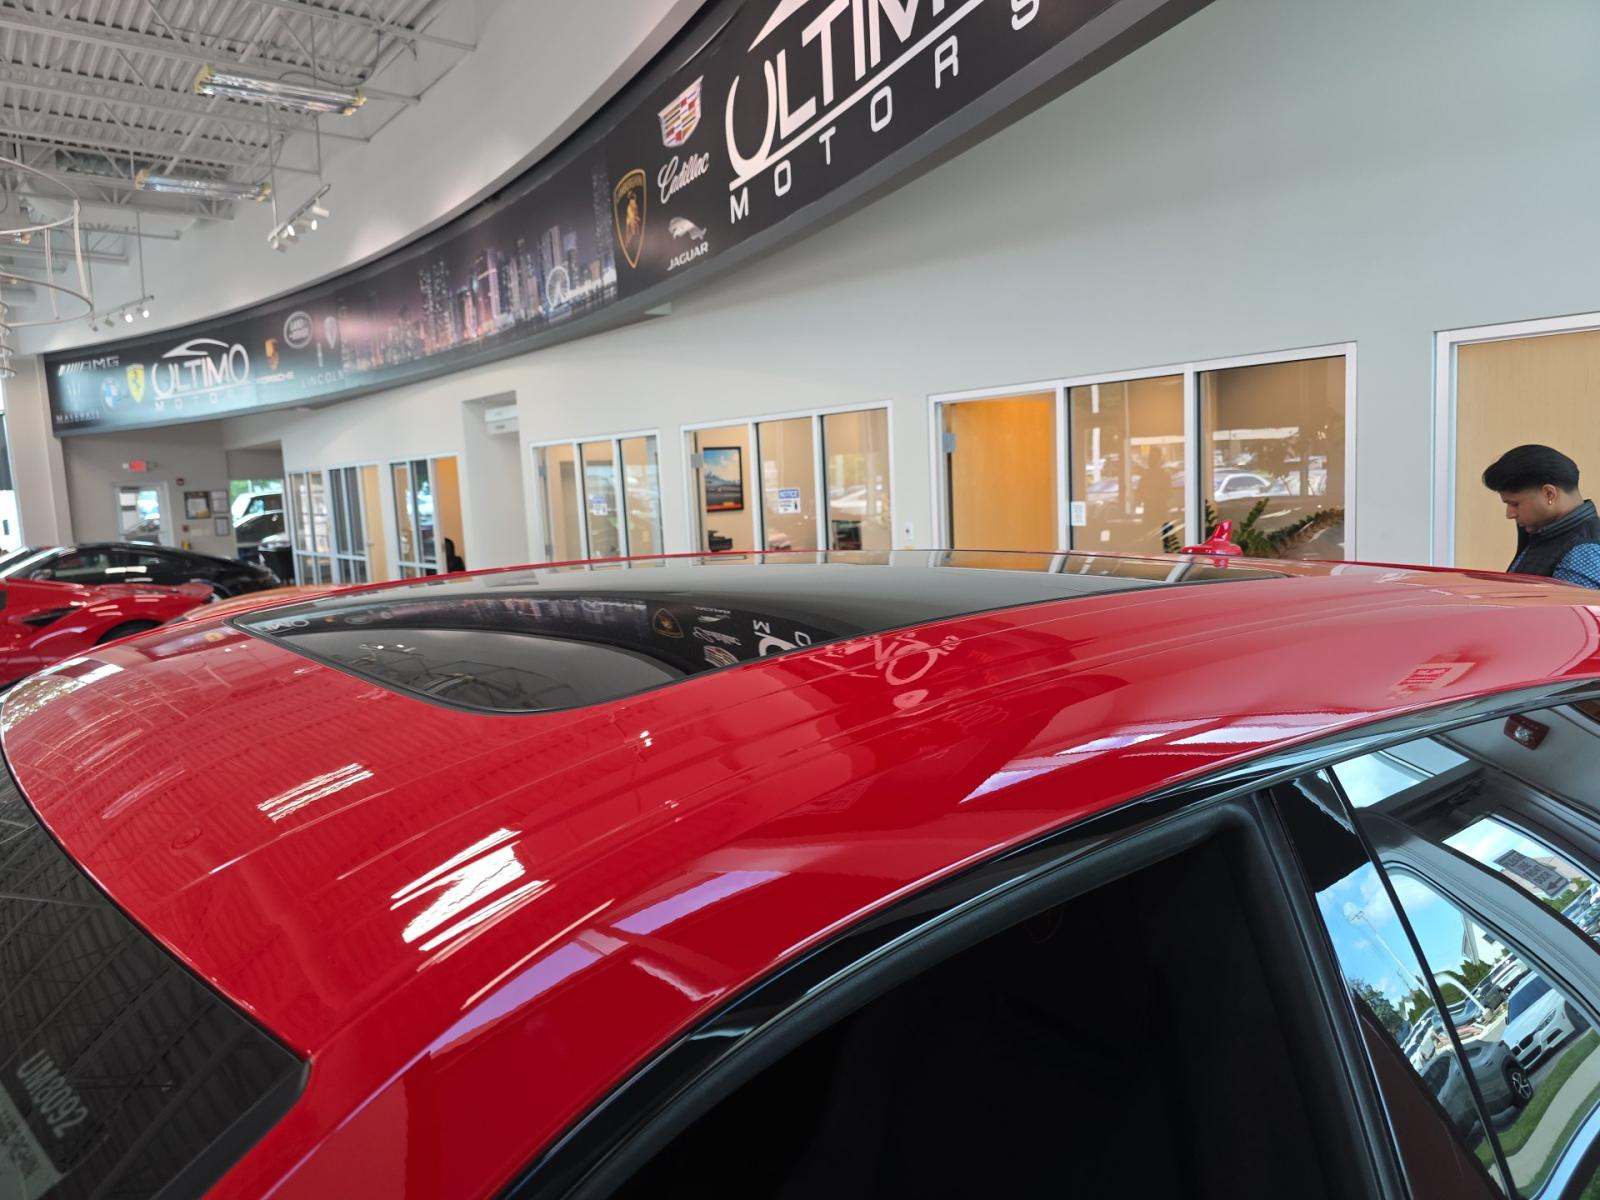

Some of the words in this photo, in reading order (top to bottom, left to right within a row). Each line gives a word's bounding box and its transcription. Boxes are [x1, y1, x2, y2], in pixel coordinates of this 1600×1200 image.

[730, 0, 1040, 224] MOTORS
[657, 152, 710, 204] Cadillac
[666, 241, 709, 271] JAGUAR
[151, 343, 250, 398] ULTIMO
[154, 389, 250, 411] MOTO
[16, 1048, 88, 1138] UM8092
